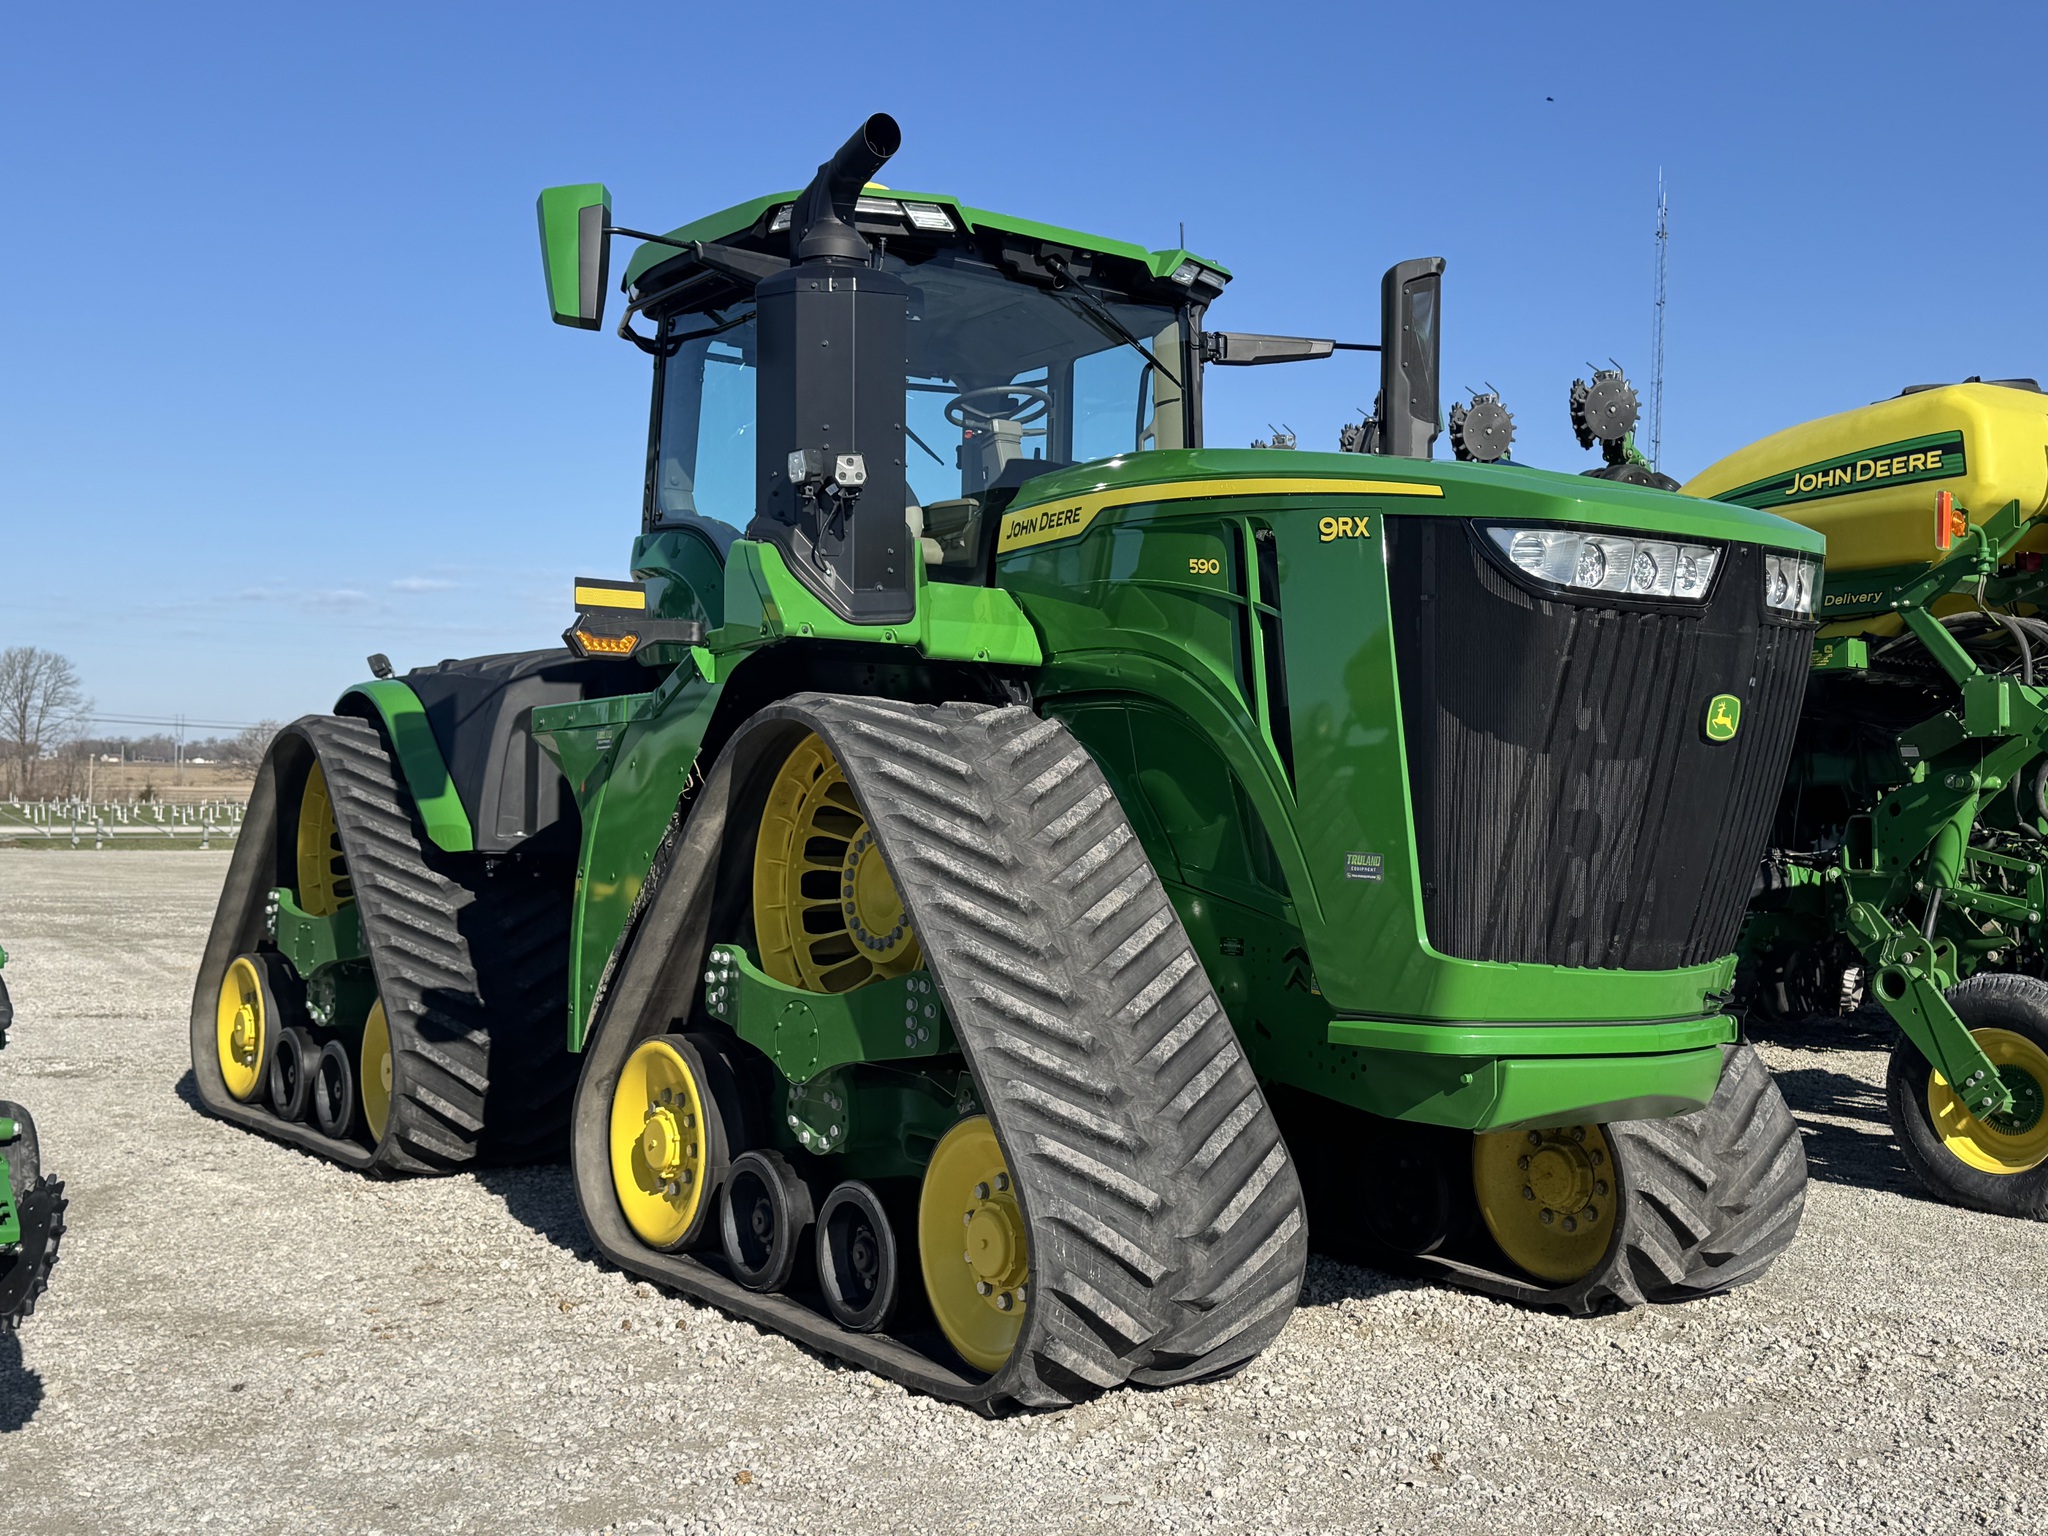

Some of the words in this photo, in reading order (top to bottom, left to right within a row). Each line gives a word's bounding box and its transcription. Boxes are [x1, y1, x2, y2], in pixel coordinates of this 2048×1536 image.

[1785, 466, 1852, 495] JOHN
[1855, 450, 1943, 482] DEERE
[1006, 517, 1038, 540] JOHN
[1039, 506, 1082, 531] DEERE
[1318, 516, 1371, 542] 9RX
[1189, 558, 1220, 575] 590
[1824, 592, 1883, 607] Delivery
[1346, 854, 1381, 867] TRULAND
